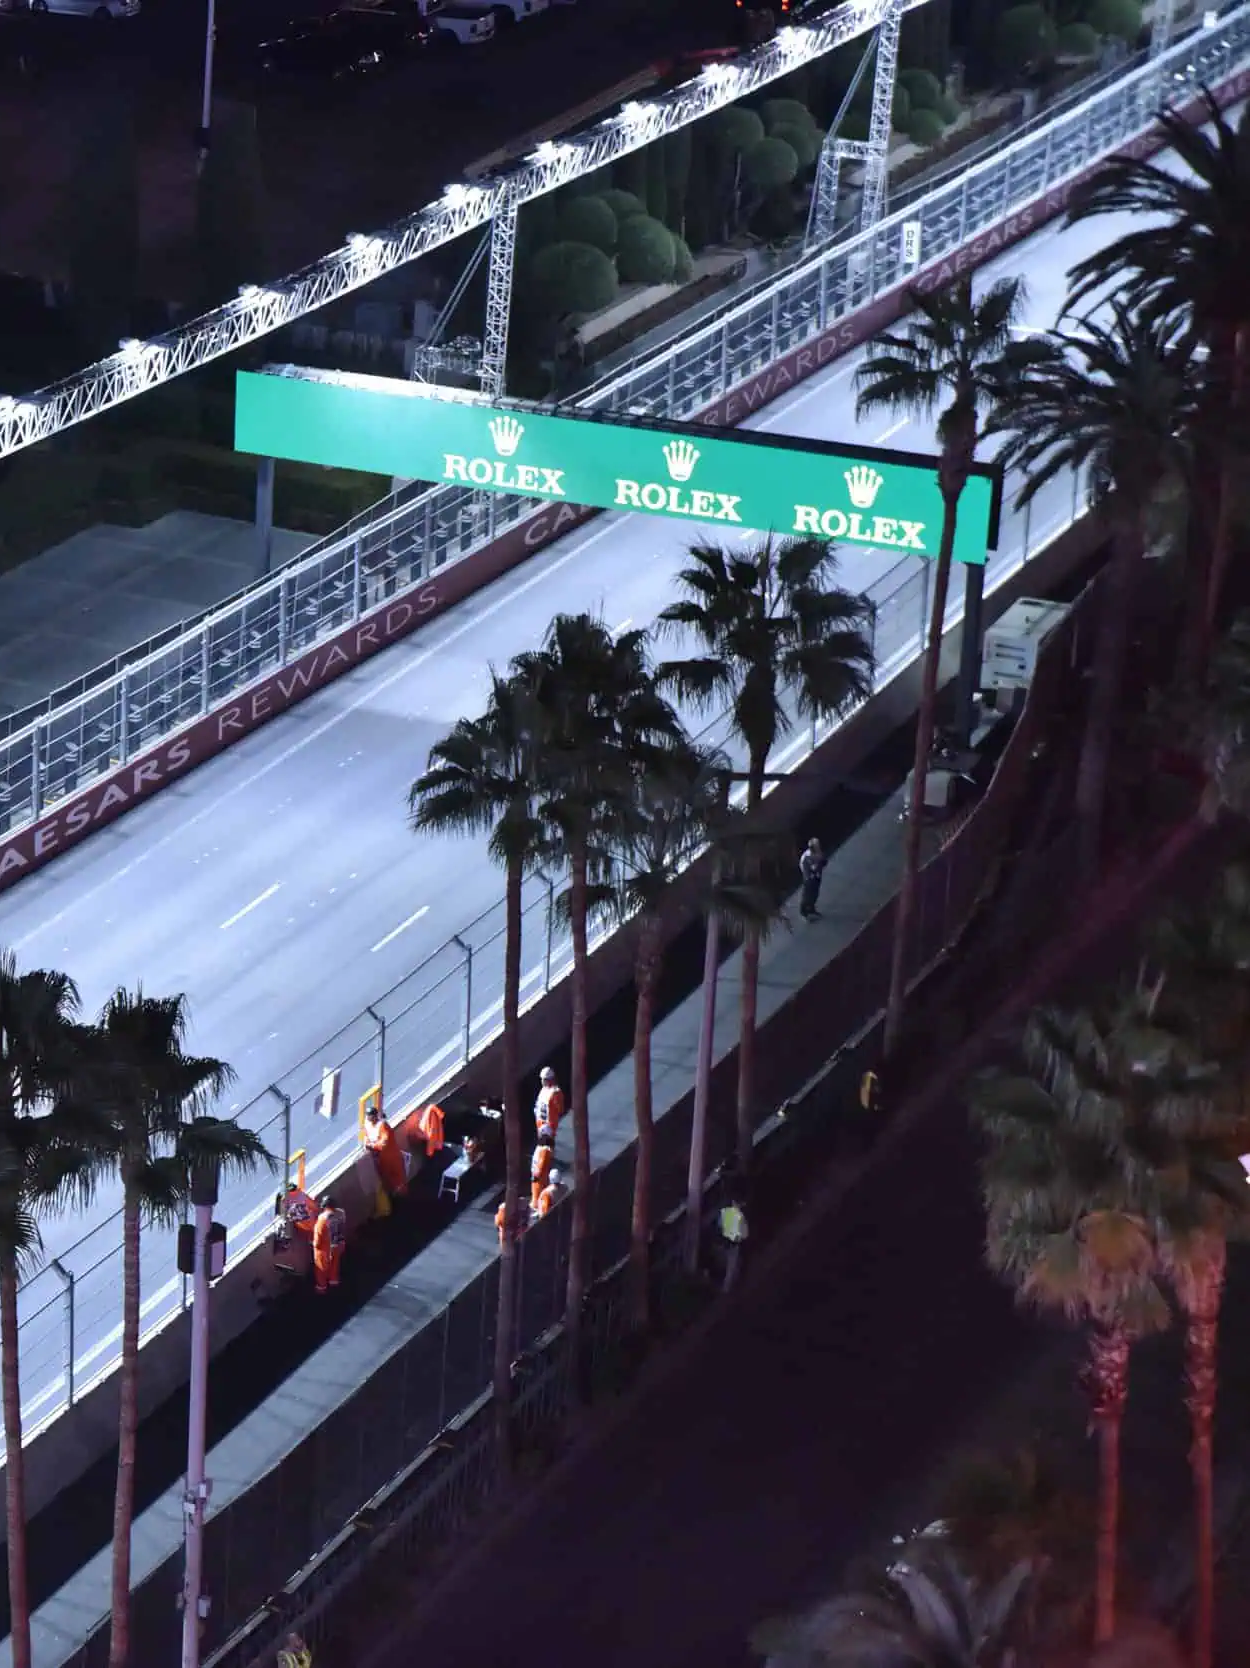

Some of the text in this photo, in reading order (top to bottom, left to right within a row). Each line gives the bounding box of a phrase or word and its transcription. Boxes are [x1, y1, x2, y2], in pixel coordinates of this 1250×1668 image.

[442, 453, 566, 496] ROLEX
[613, 478, 743, 522] ROLEX
[792, 504, 926, 549] ROLEX
[217, 584, 439, 741] REWARDS
